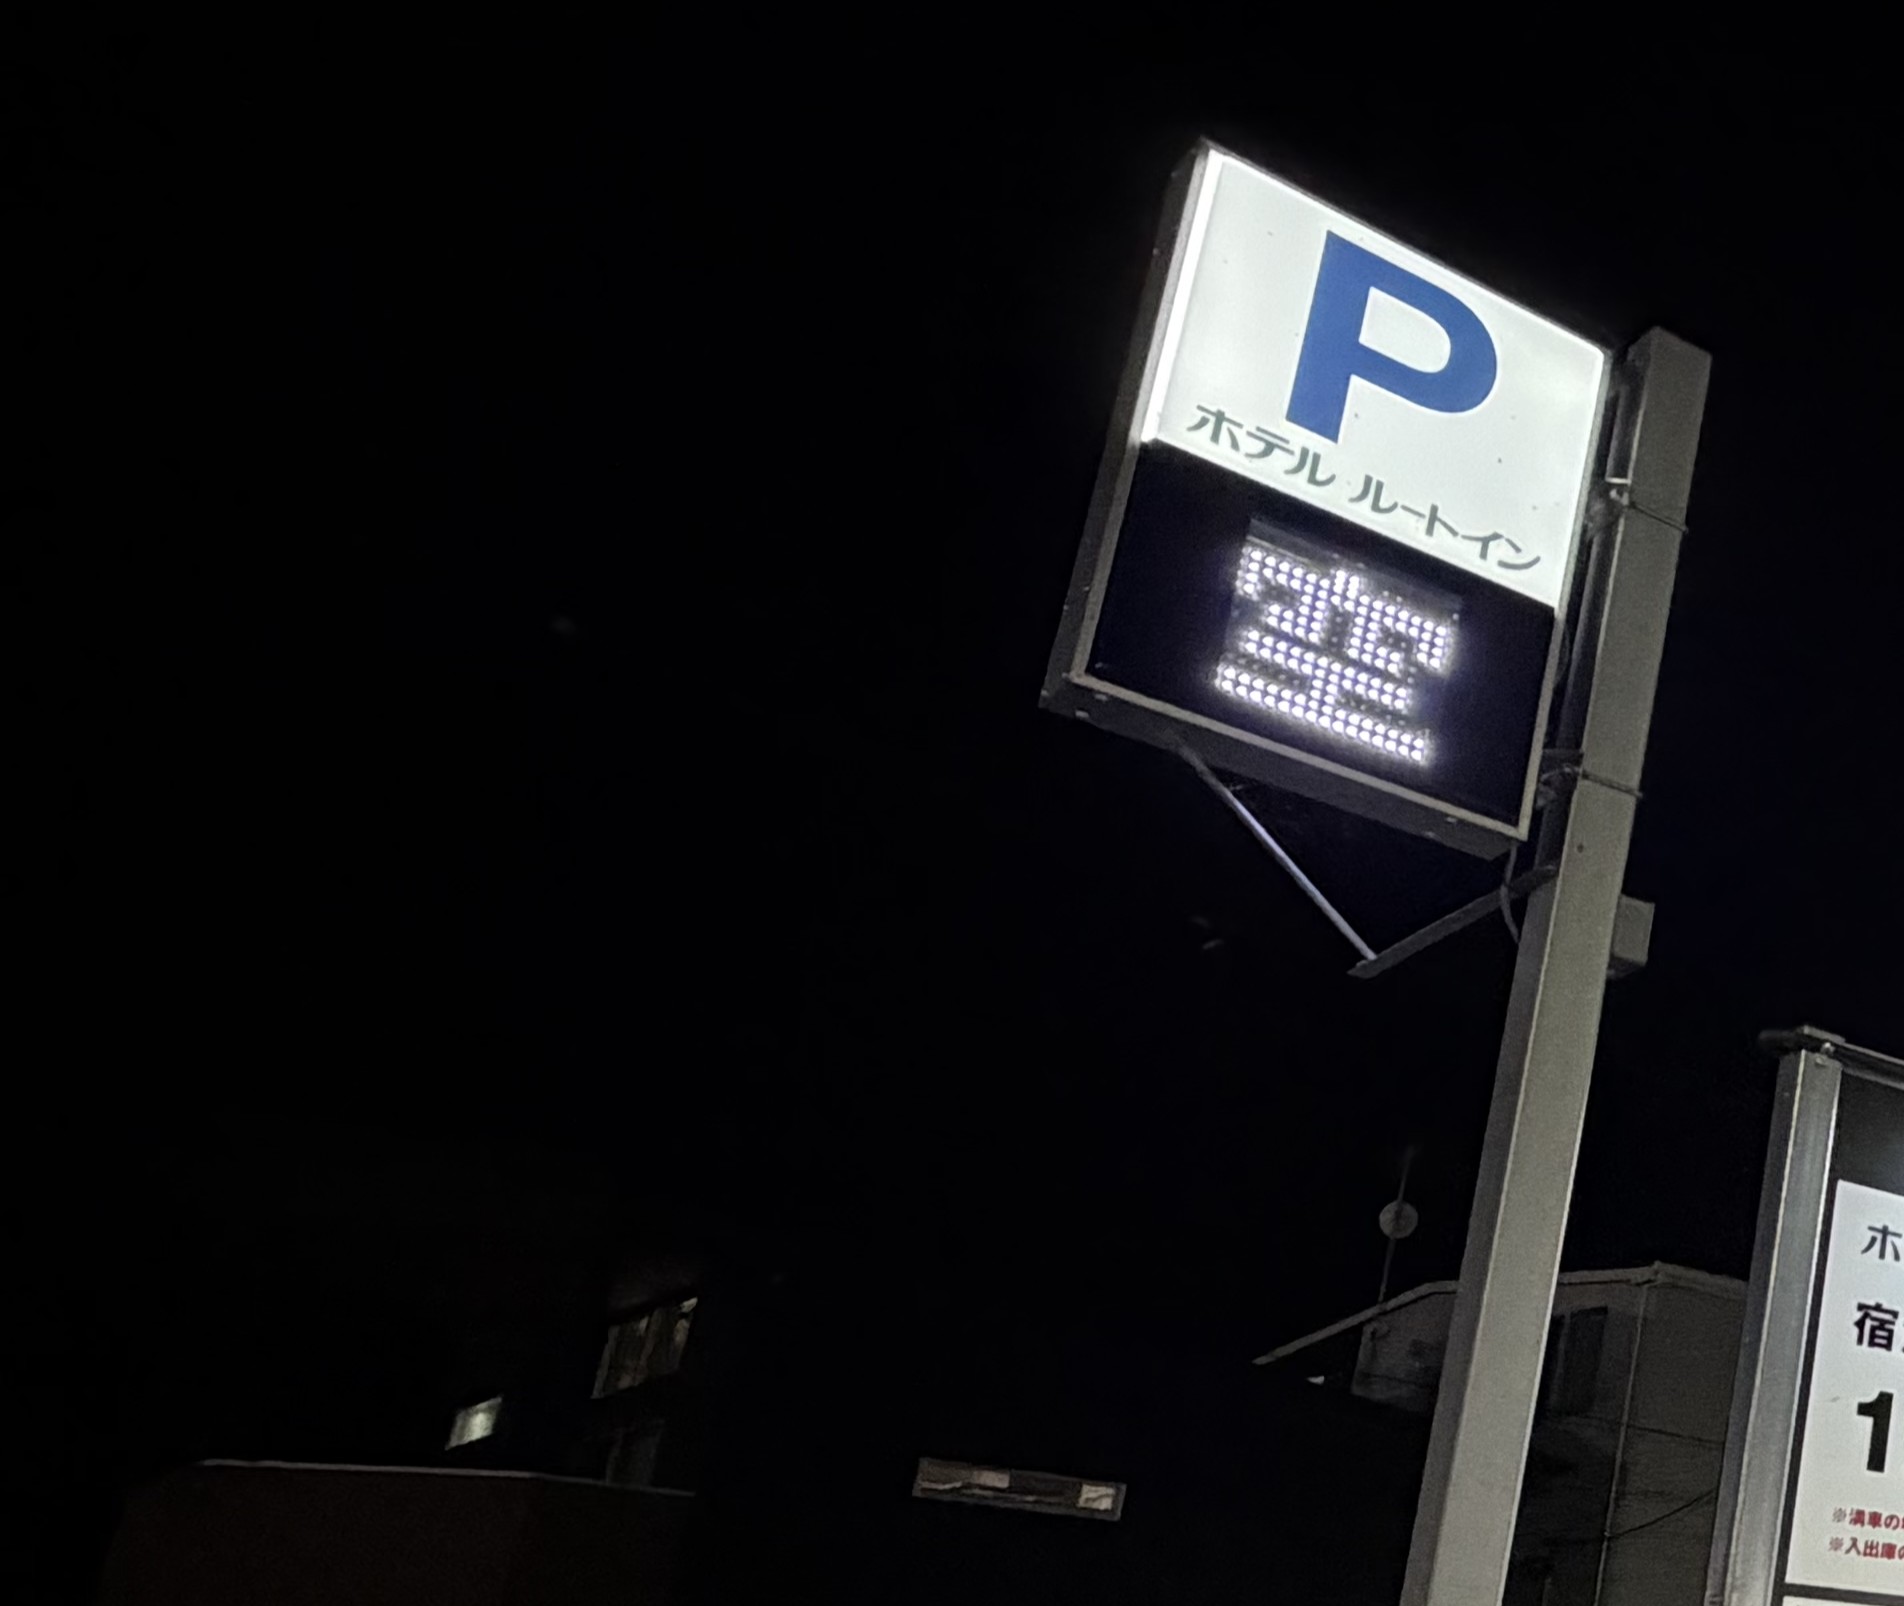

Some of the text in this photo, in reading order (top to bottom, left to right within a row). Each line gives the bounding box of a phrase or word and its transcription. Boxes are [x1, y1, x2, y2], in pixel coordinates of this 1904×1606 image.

[1286, 230, 1498, 444] P
[1187, 403, 1542, 573] ホテル ルートイン
[1213, 546, 1452, 764] 空
